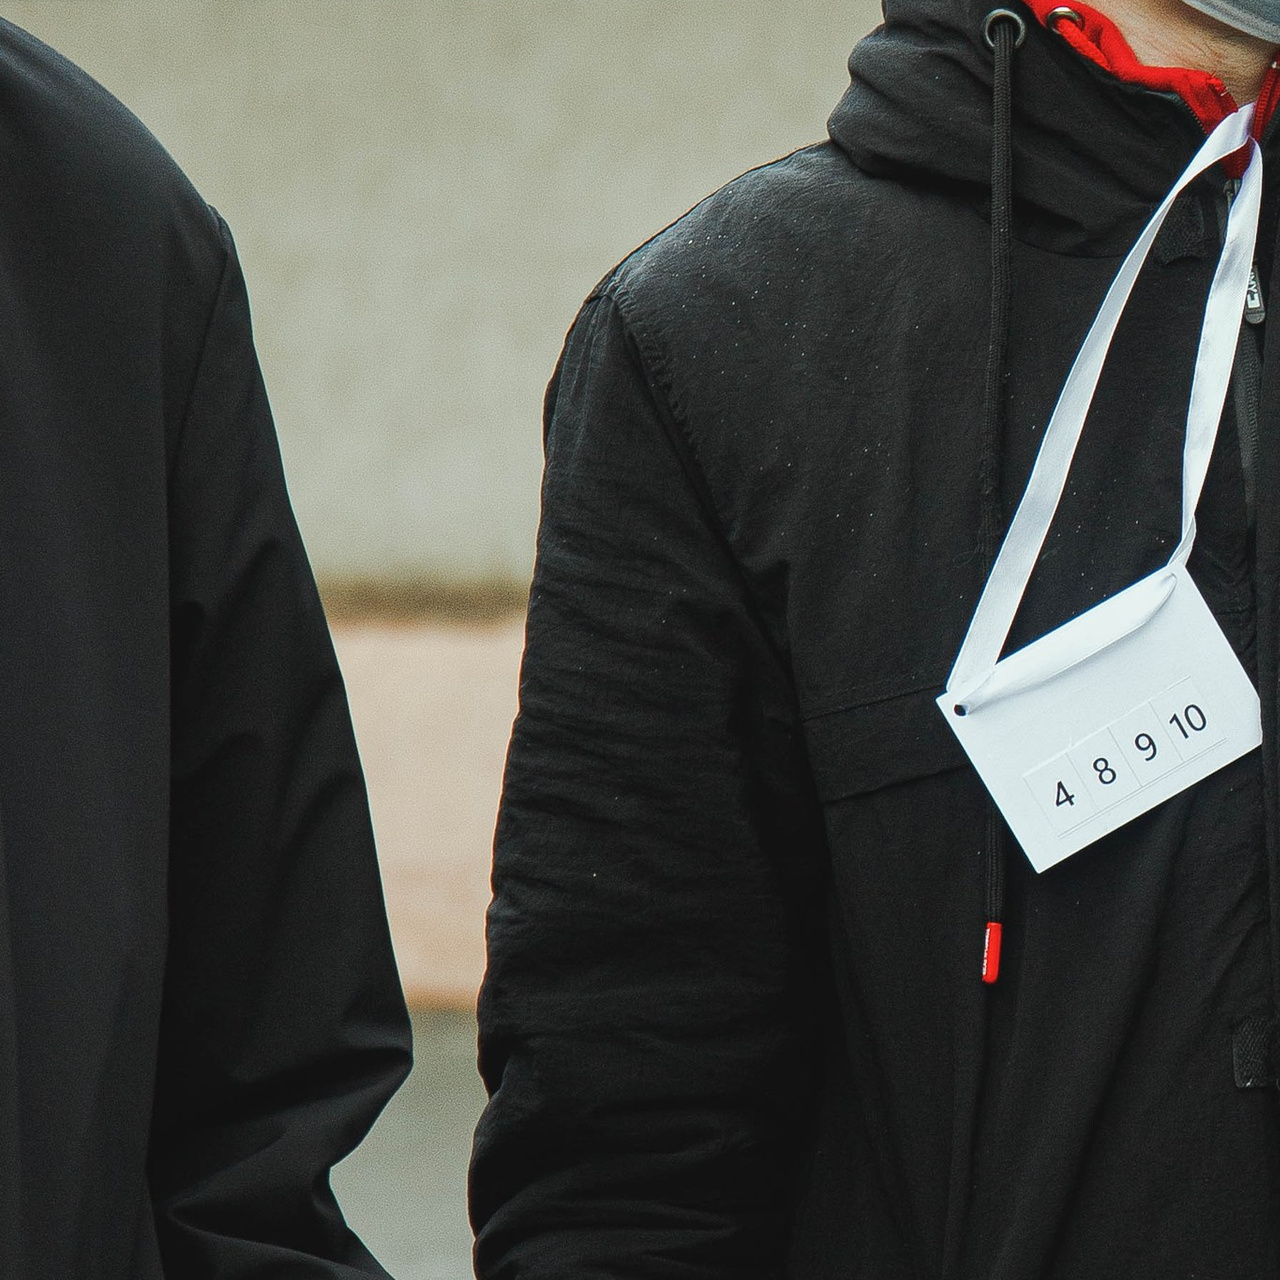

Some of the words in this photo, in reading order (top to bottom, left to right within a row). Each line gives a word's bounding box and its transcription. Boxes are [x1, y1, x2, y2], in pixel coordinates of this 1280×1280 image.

[1055, 780, 1076, 808] 4
[1092, 757, 1117, 785] 8
[1134, 732, 1158, 762] 9
[1168, 704, 1208, 740] 10
